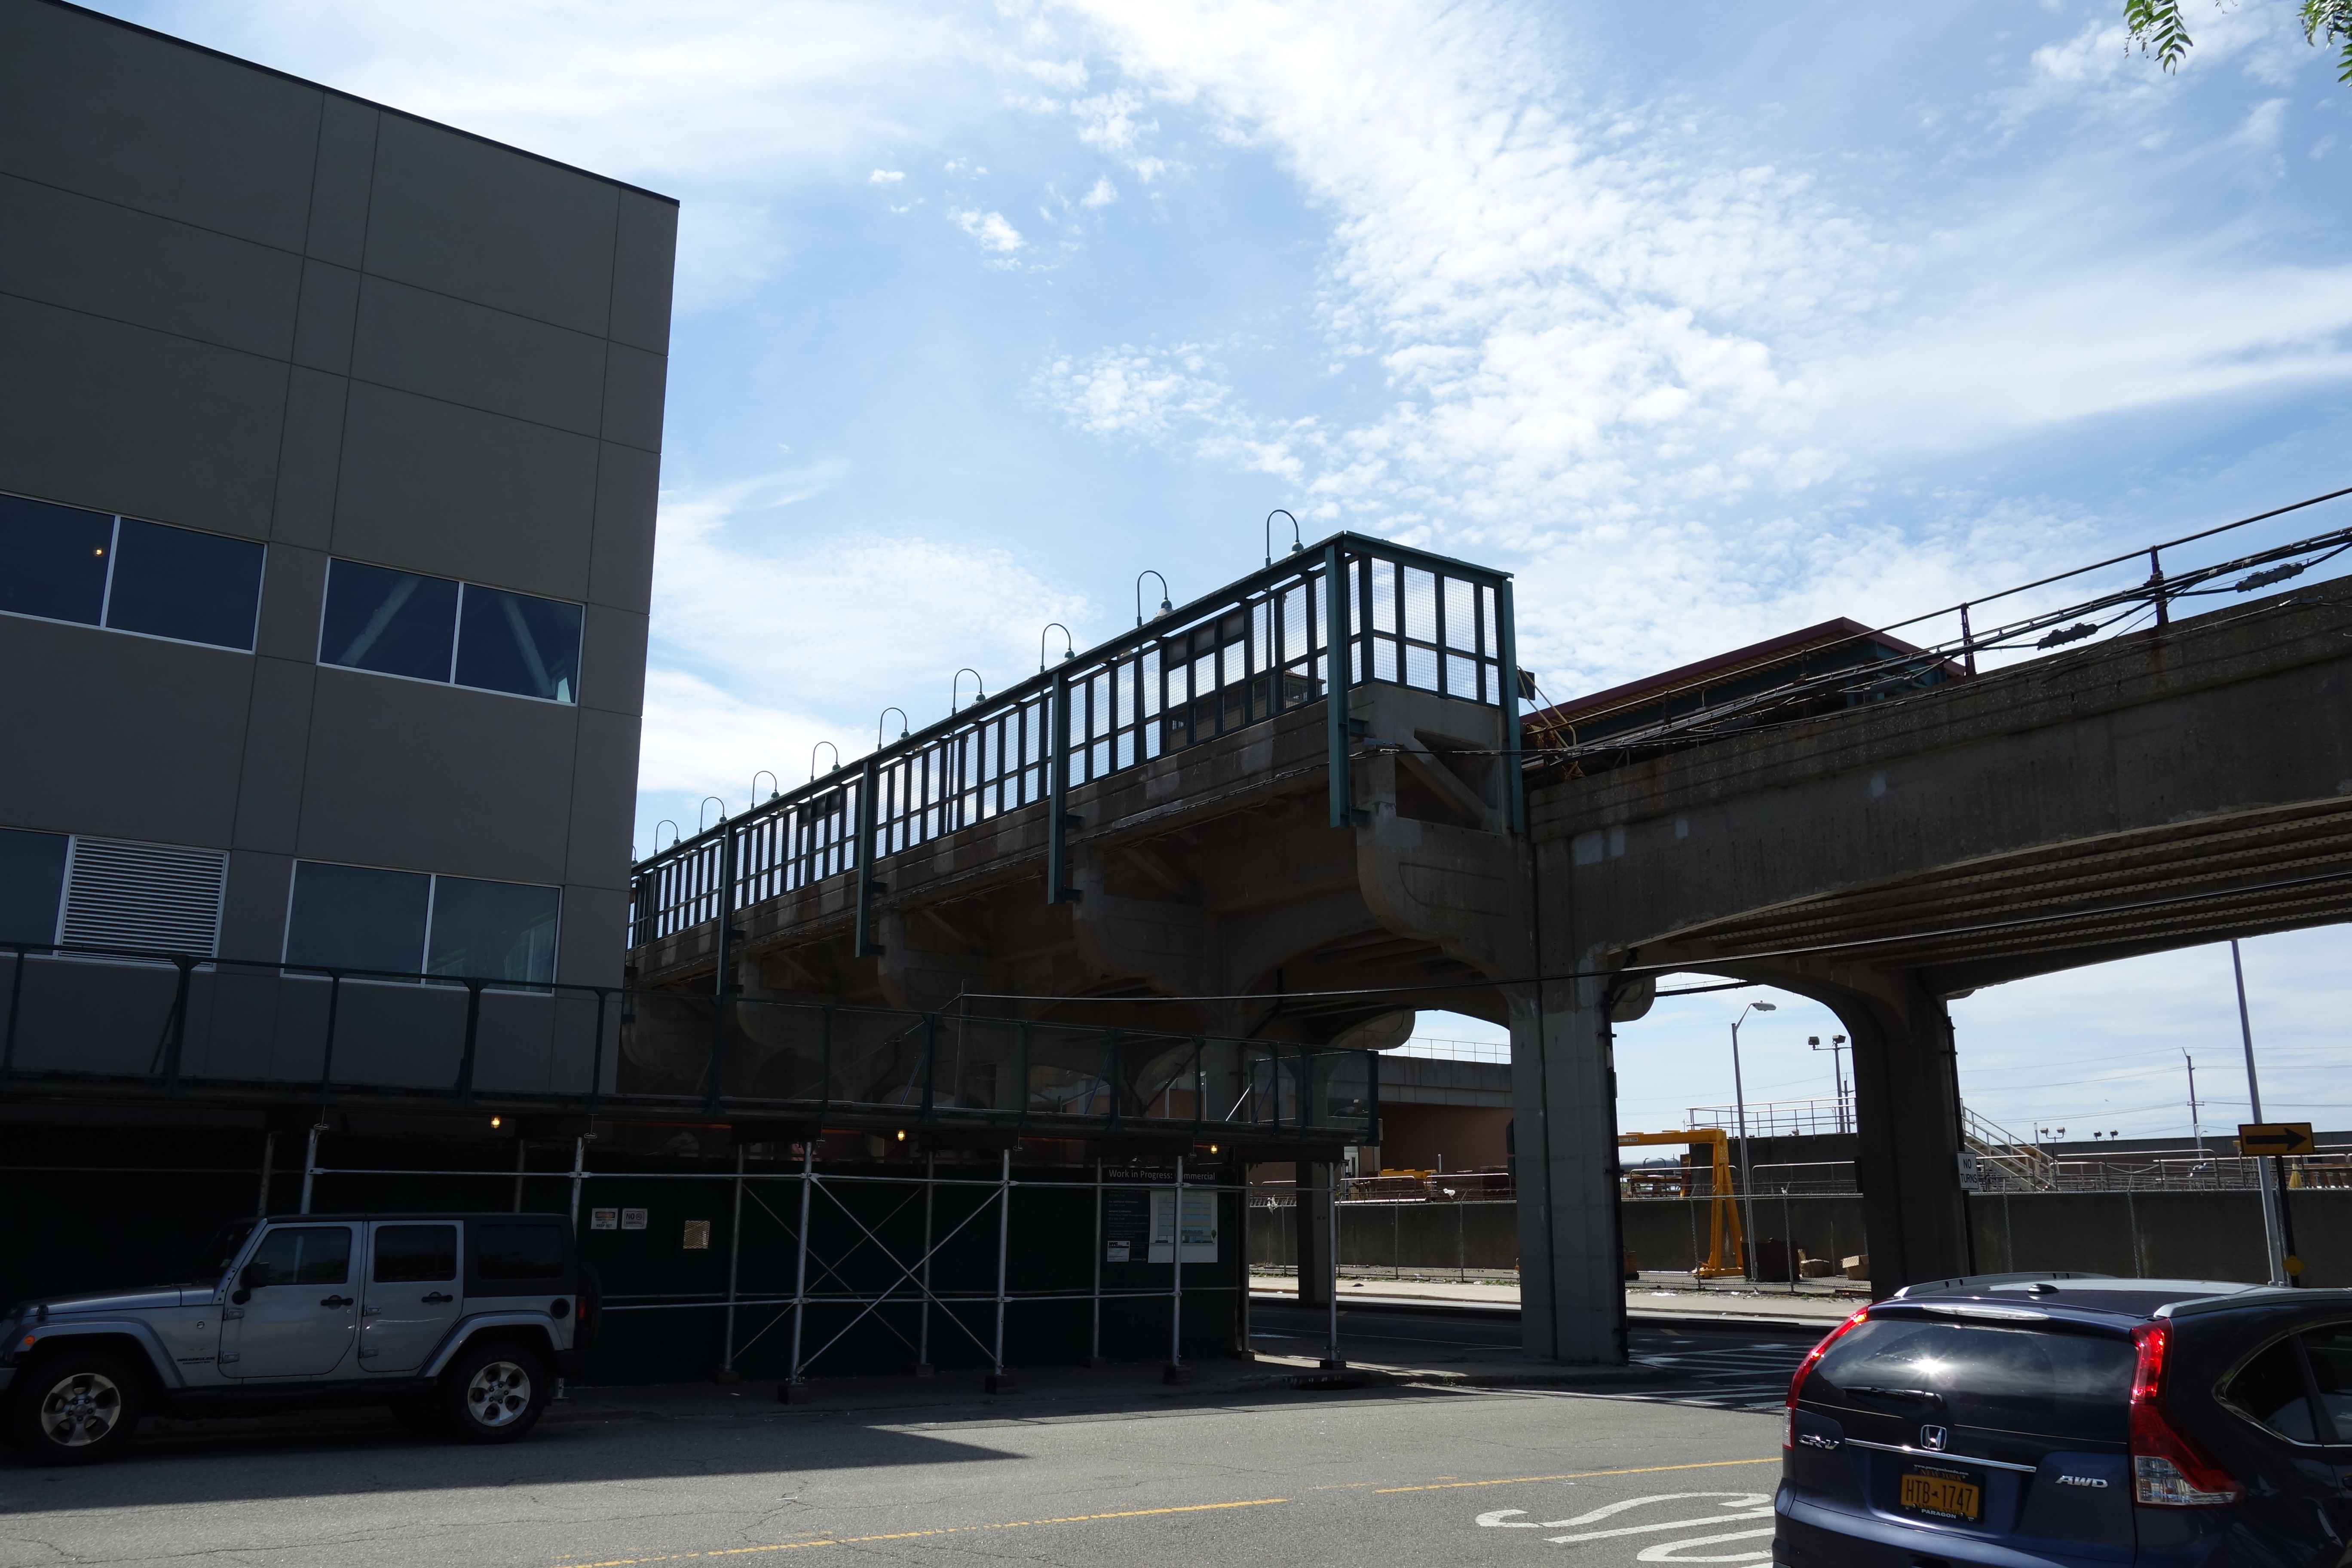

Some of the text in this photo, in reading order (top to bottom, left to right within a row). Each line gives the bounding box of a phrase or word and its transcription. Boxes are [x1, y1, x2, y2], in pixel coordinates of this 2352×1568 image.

[1963, 1158, 1972, 1169] NO
[1109, 1169, 1216, 1180] Work in Progress: mmercial
[1960, 1173, 1977, 1183] TURNS
[1798, 1434, 1840, 1450] CR-V
[1920, 1469, 1963, 1482] NEW YORK
[2055, 1475, 2108, 1488] AWD
[1906, 1479, 1972, 1511] HTB 1747
[1921, 1509, 1957, 1519] PARAGON
